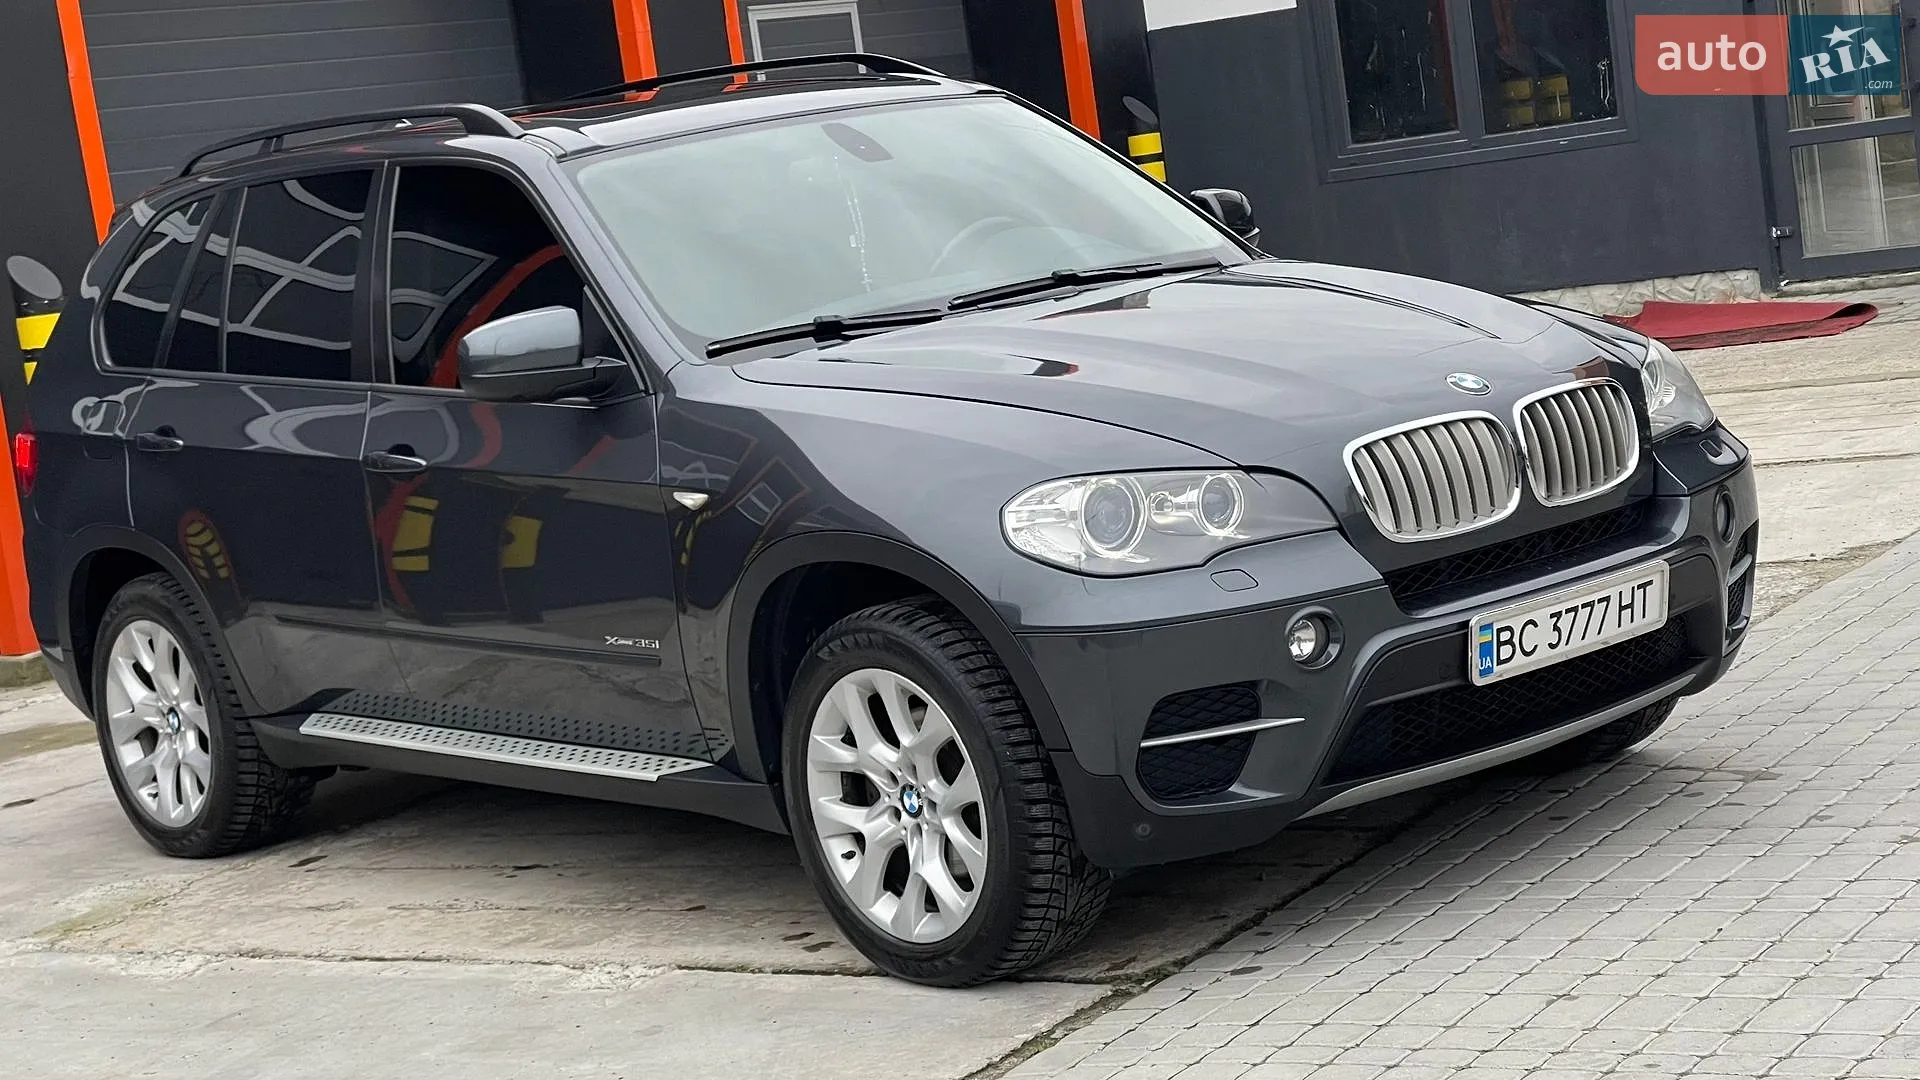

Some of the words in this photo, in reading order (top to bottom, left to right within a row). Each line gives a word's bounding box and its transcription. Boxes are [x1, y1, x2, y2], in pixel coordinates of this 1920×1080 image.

[1496, 618, 1538, 667] BC
[1547, 594, 1611, 650] 3777
[1617, 579, 1654, 628] HT
[1478, 658, 1492, 670] UA
